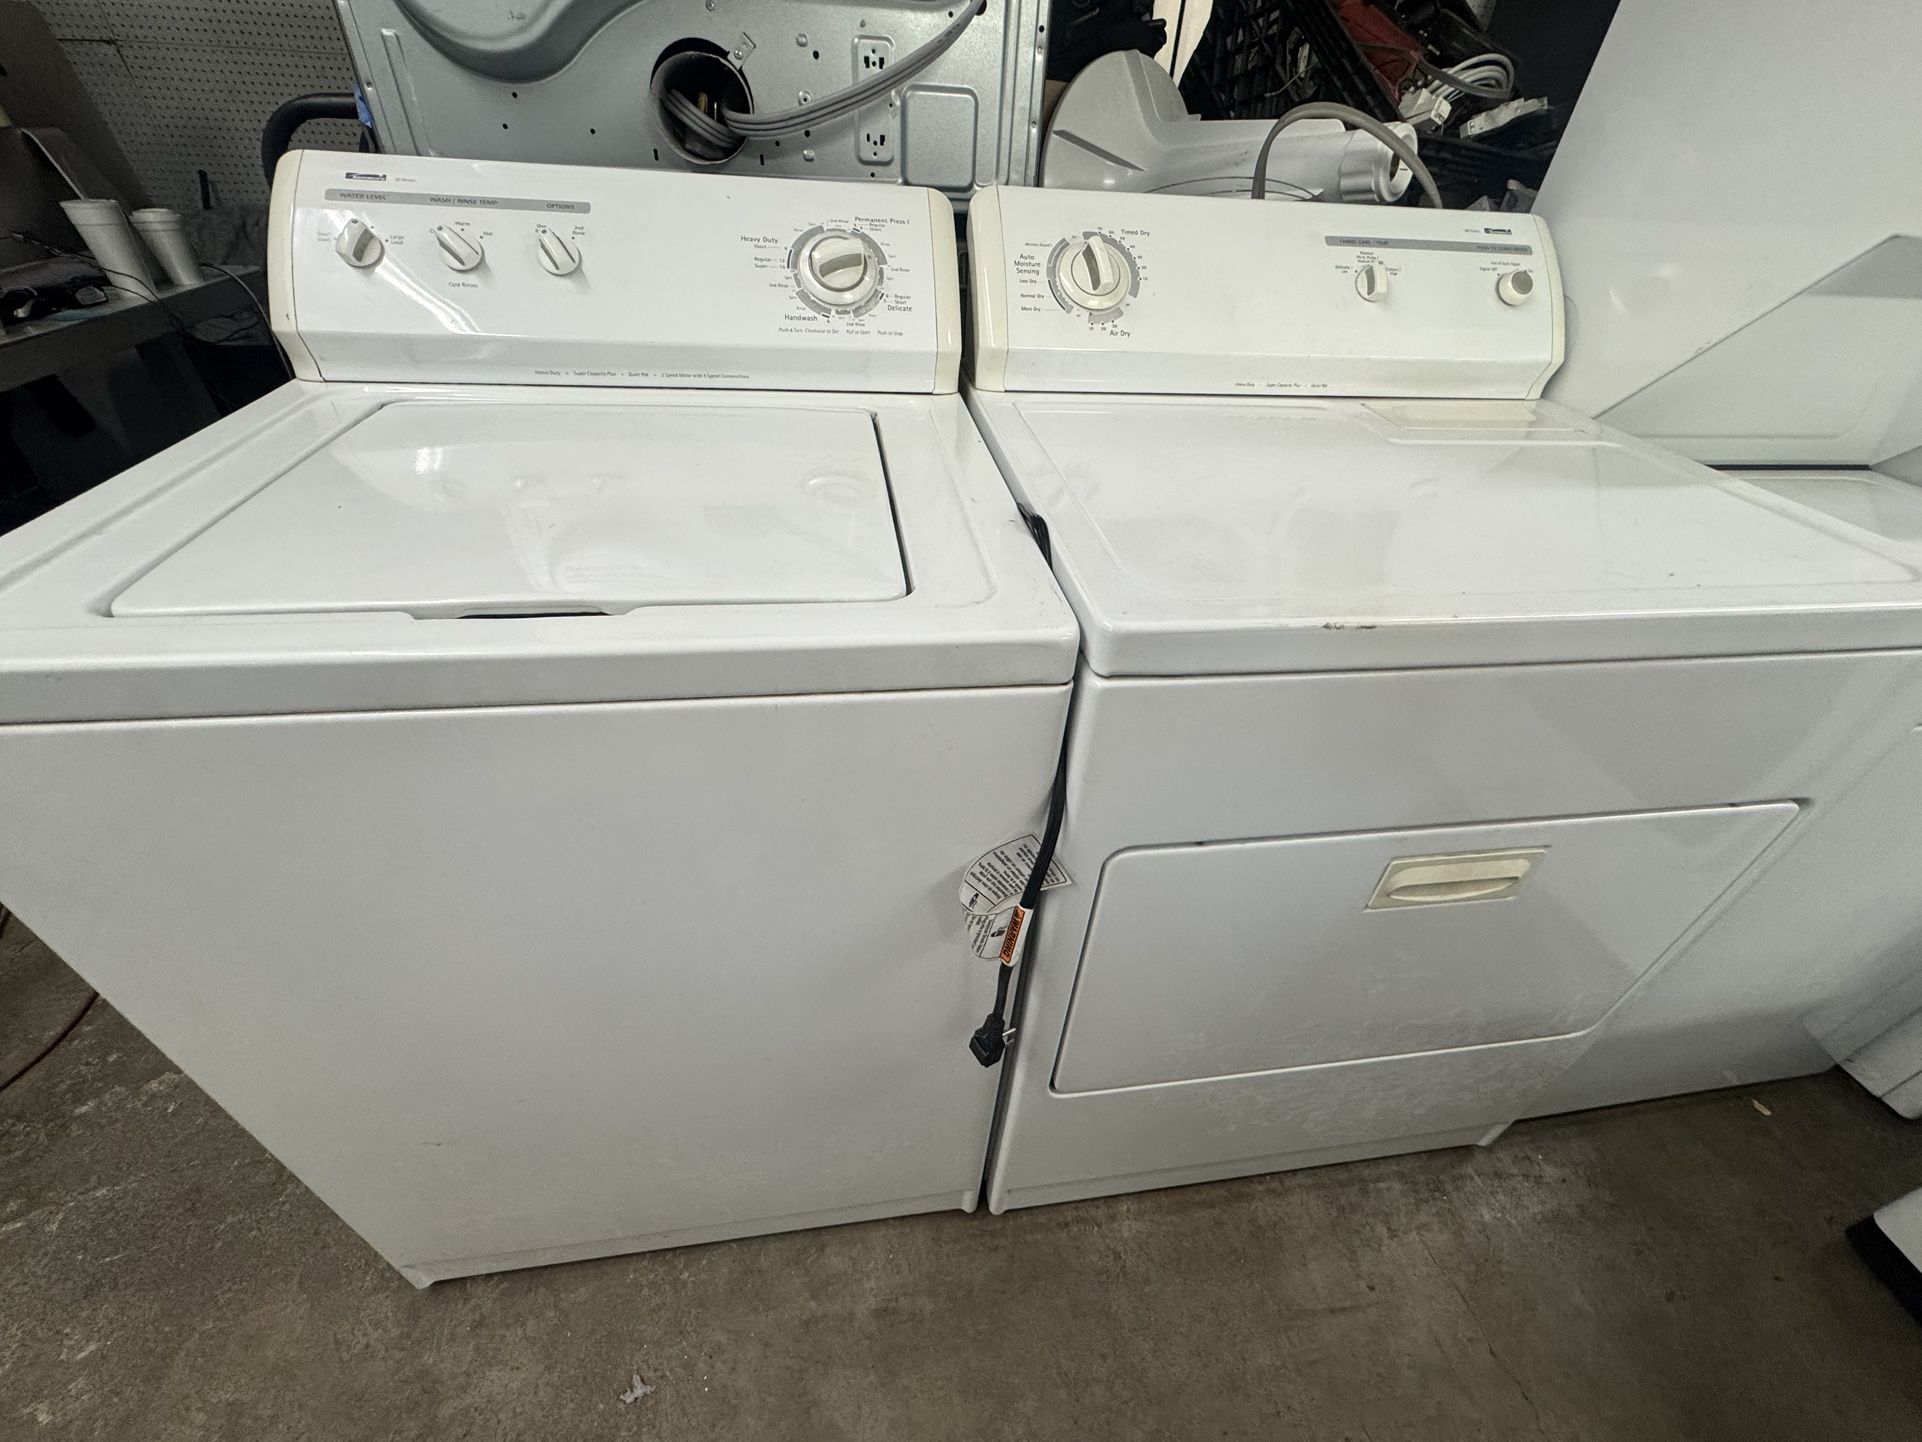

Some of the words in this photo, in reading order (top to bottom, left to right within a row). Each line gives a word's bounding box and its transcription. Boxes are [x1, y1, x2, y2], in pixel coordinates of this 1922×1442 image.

[855, 216, 888, 224] Permanent
[890, 217, 906, 225] Press
[1121, 228, 1138, 236] Timed
[1140, 229, 1150, 237] Dry
[740, 235, 760, 243] Heavy
[762, 236, 778, 244] Duty
[1016, 267, 1040, 276] Sensing
[887, 304, 913, 312] Delicate
[784, 313, 818, 322] Handwash
[1109, 329, 1119, 337] Air
[1120, 330, 1130, 338] Dry
[1003, 914, 1022, 958] WARNING
